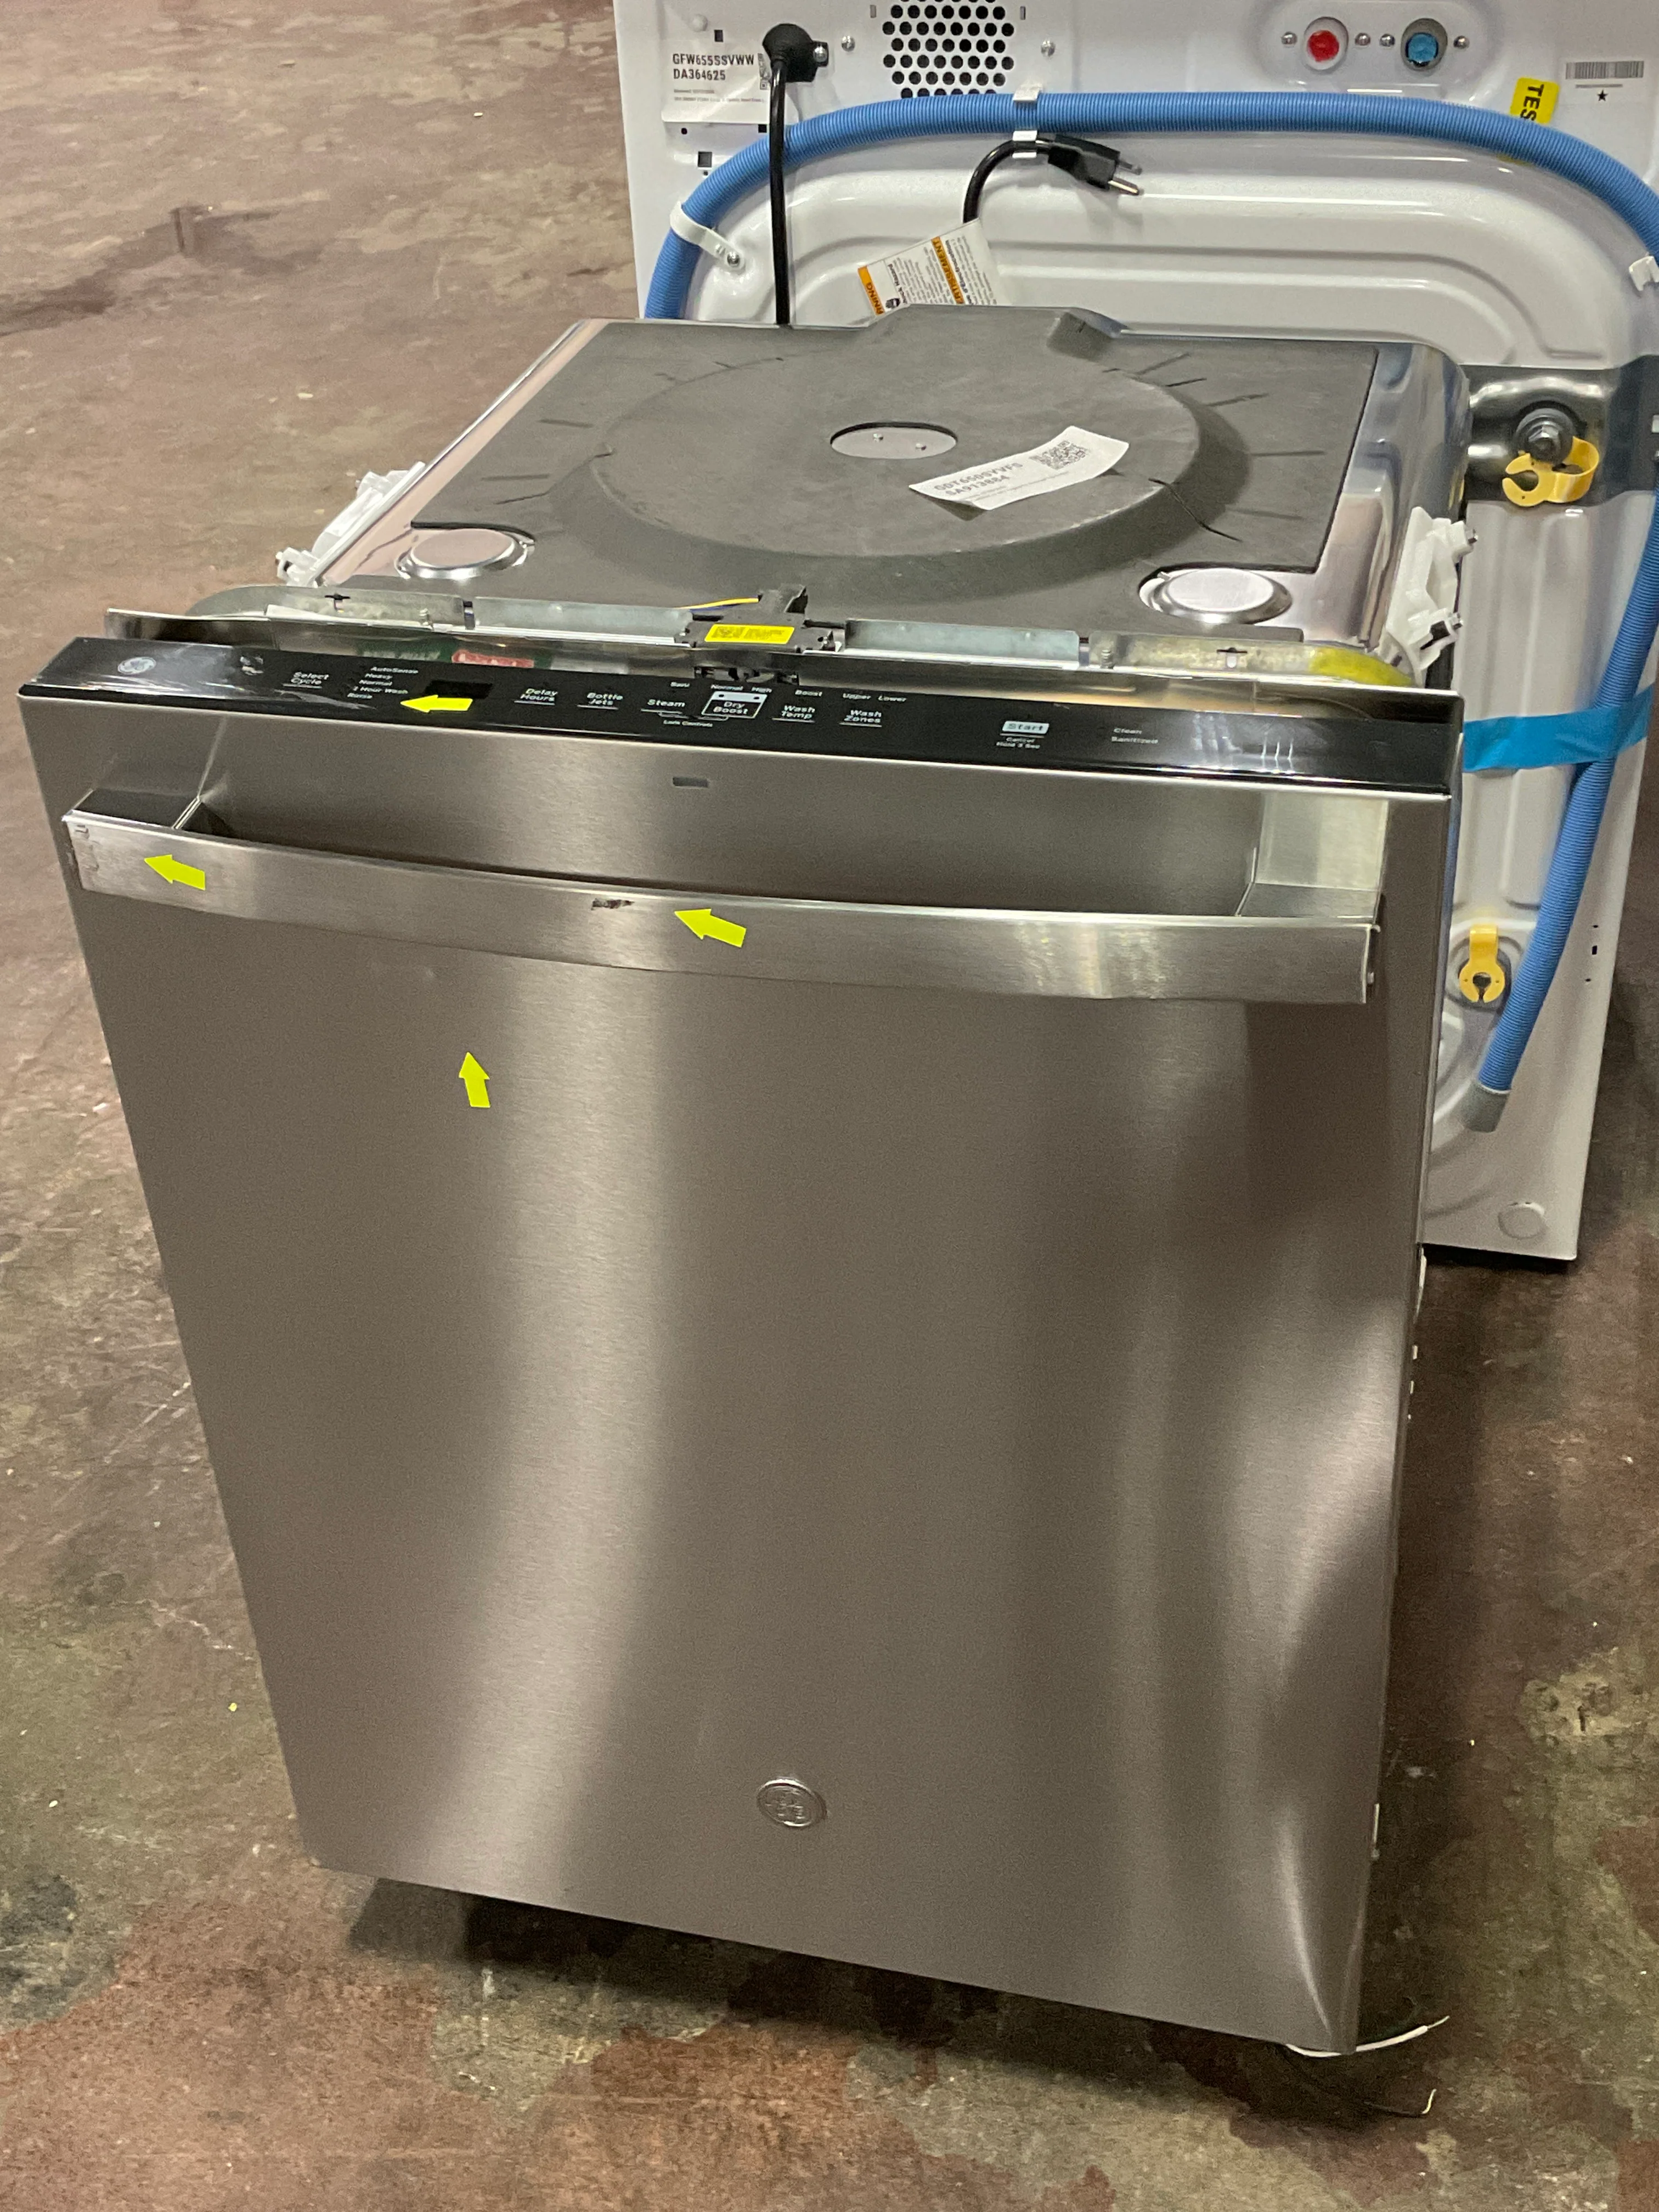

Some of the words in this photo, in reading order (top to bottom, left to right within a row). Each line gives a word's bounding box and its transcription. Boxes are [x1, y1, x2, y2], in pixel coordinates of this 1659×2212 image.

[673, 53, 754, 66] GFW655SSVWW
[673, 69, 726, 81] DA364625
[294, 672, 329, 680] Select
[526, 688, 558, 697] Delay
[795, 689, 823, 697] Boost
[647, 698, 685, 707] Steam
[713, 706, 748, 714] Boost
[784, 705, 815, 713] Wash
[850, 709, 882, 718] Wash
[781, 710, 812, 719] Temp
[844, 715, 881, 723] Zones
